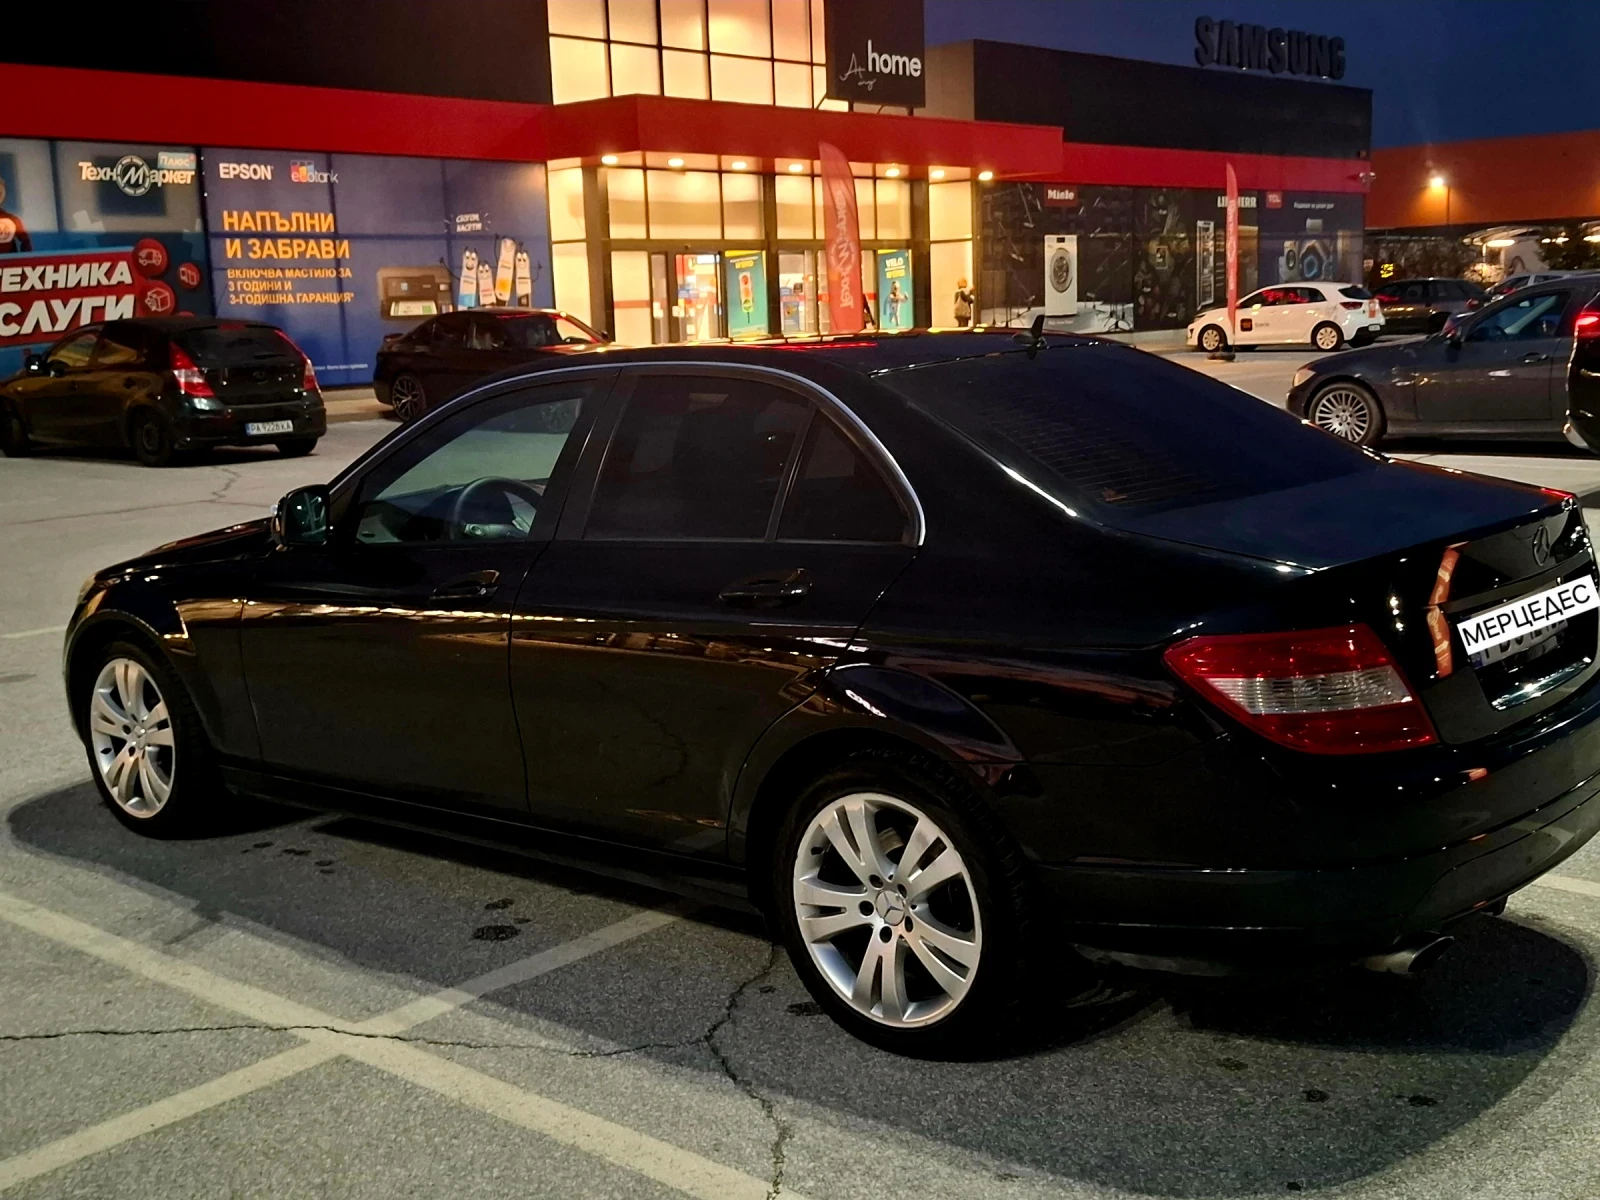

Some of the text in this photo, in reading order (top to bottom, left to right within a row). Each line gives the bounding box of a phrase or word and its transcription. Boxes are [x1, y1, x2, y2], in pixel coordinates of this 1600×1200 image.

[1194, 15, 1345, 80] SAMSUNG
[867, 39, 921, 77] home
[219, 162, 272, 180] EPSON
[1047, 189, 1075, 200] Miele
[223, 210, 335, 232] НАПЪЛНИ
[225, 238, 350, 259] И ЗАБРАВИ
[0, 261, 133, 292] ЕХНИКА
[227, 267, 353, 279] ВКЛЮЧВА МАСТИЛО ЗА
[228, 281, 292, 292] 3 ГОДИНИ И
[229, 294, 294, 306] 3-ГОДИШНА
